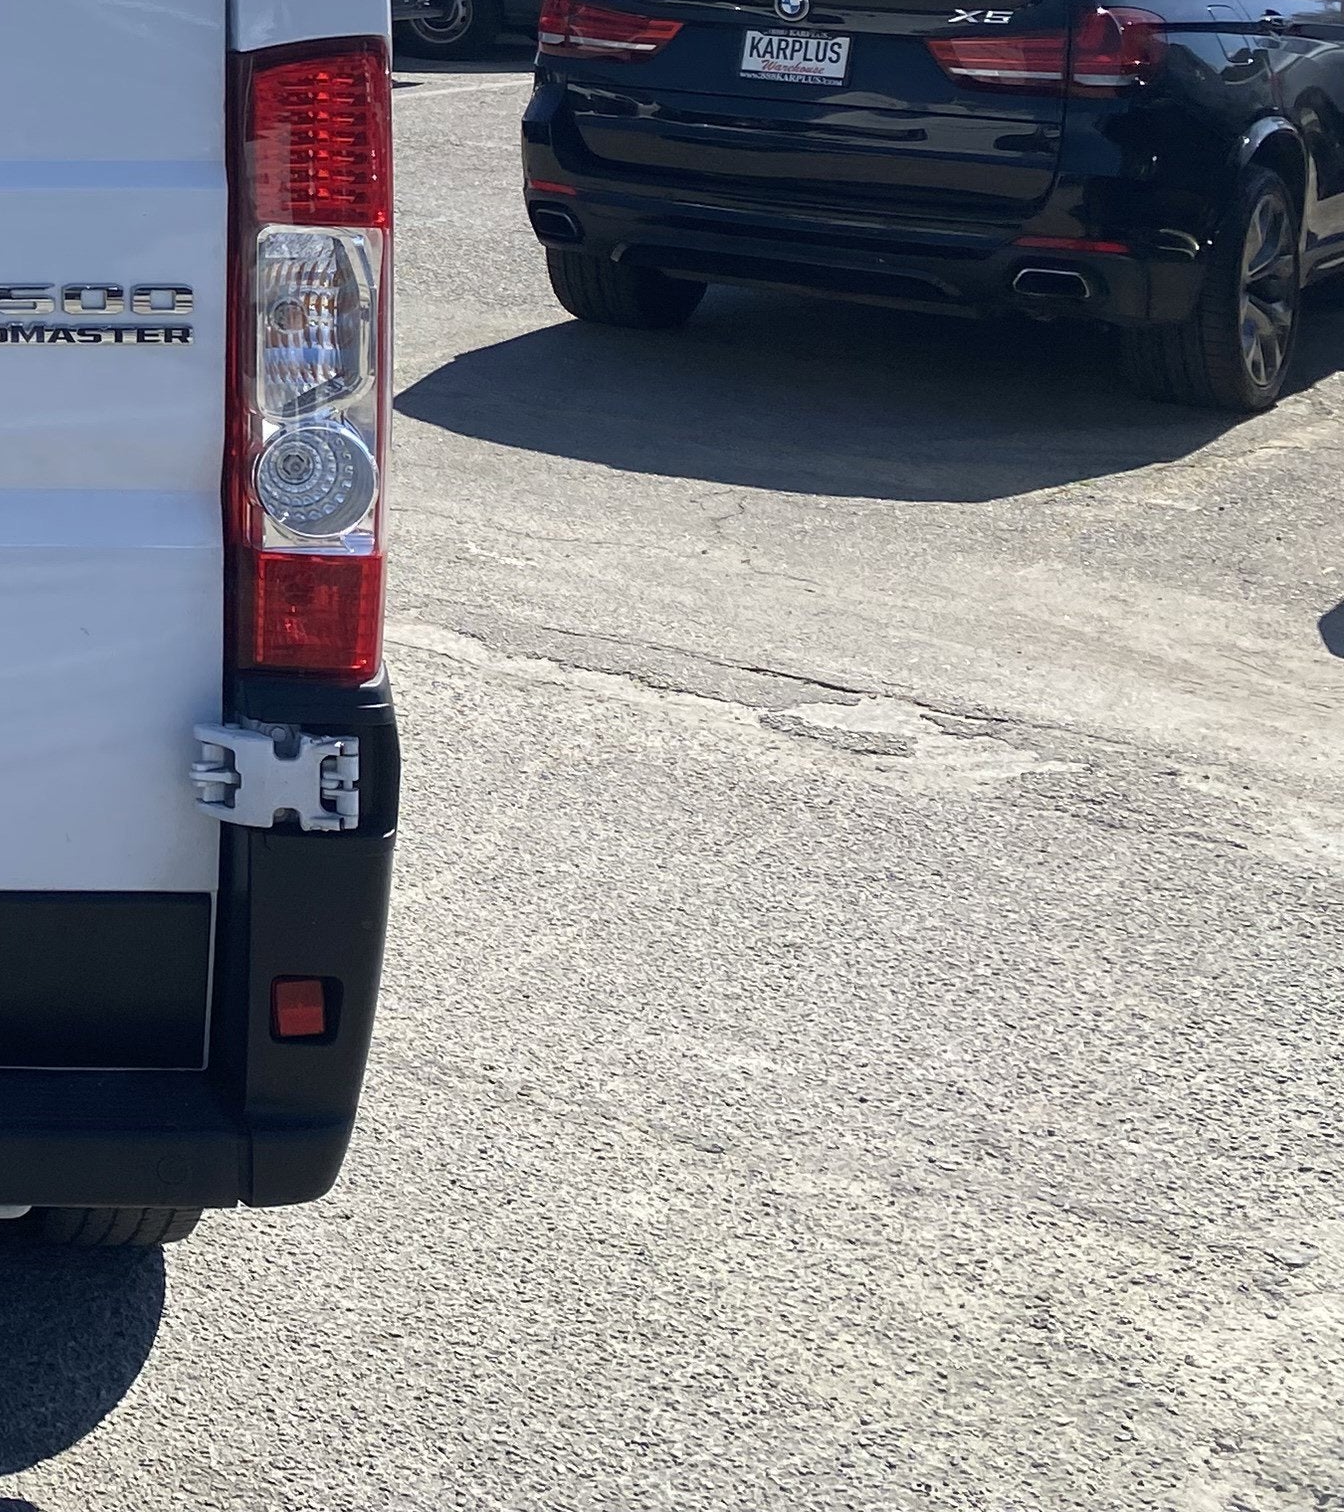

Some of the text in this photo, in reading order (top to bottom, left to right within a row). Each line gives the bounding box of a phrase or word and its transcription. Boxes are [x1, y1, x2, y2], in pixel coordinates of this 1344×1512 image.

[948, 9, 1014, 24] X5
[749, 36, 843, 64] KARPLUS
[761, 59, 825, 75] Warehouse
